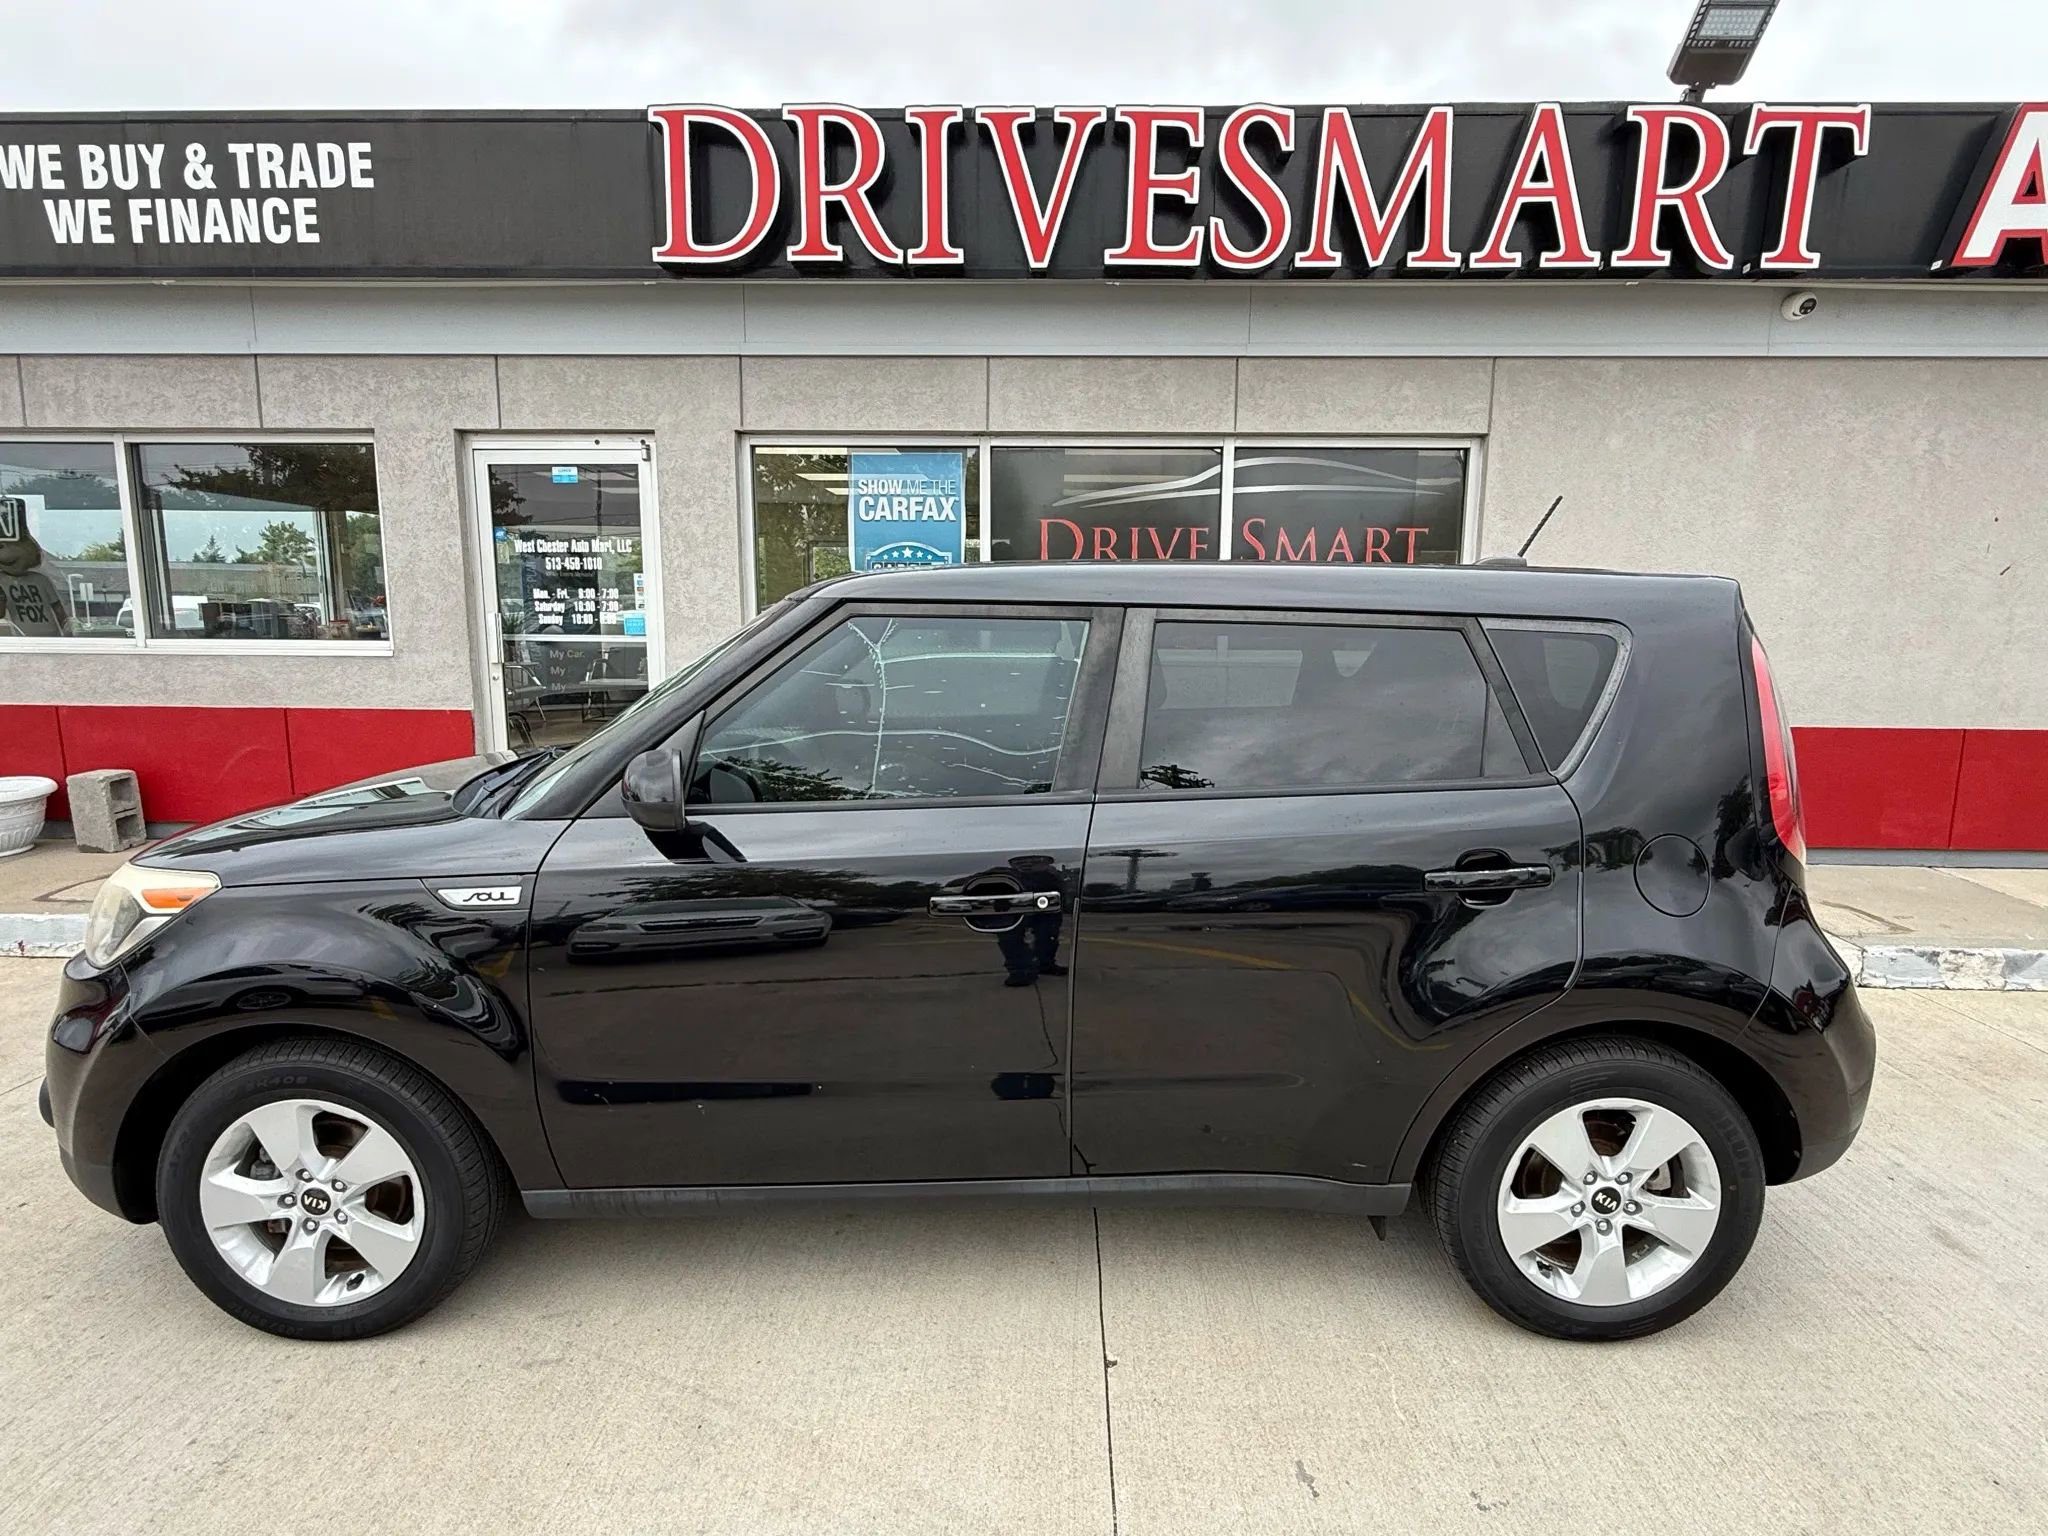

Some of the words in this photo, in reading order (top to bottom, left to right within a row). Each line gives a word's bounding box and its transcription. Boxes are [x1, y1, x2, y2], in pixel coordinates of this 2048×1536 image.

[0, 144, 65, 190] WE
[78, 143, 165, 190] BUY
[184, 142, 217, 190] &
[227, 142, 375, 189] TRADE
[648, 102, 1871, 270] DRIVESMART
[42, 198, 115, 244] WE
[128, 197, 320, 244] FINANCE
[858, 479, 903, 495] SHOW
[906, 479, 927, 495] ME
[930, 479, 957, 495] THE
[858, 495, 959, 521] CARFAX
[513, 538, 535, 553] West
[536, 538, 569, 553] Chester
[571, 538, 590, 553] Auto
[616, 538, 633, 553] LLC
[1038, 518, 1210, 561] DRIVE
[1242, 518, 1430, 564] SMART
[545, 556, 603, 571] 513-458-1010
[9, 584, 43, 604] CAR
[15, 604, 49, 624] FOX
[534, 600, 566, 613] Saturday
[538, 613, 564, 626] Sunday
[549, 649, 565, 661] My
[550, 665, 566, 677] My
[551, 682, 567, 694] My
[304, 1194, 328, 1211] KIA
[1594, 1191, 1618, 1211] KIA
